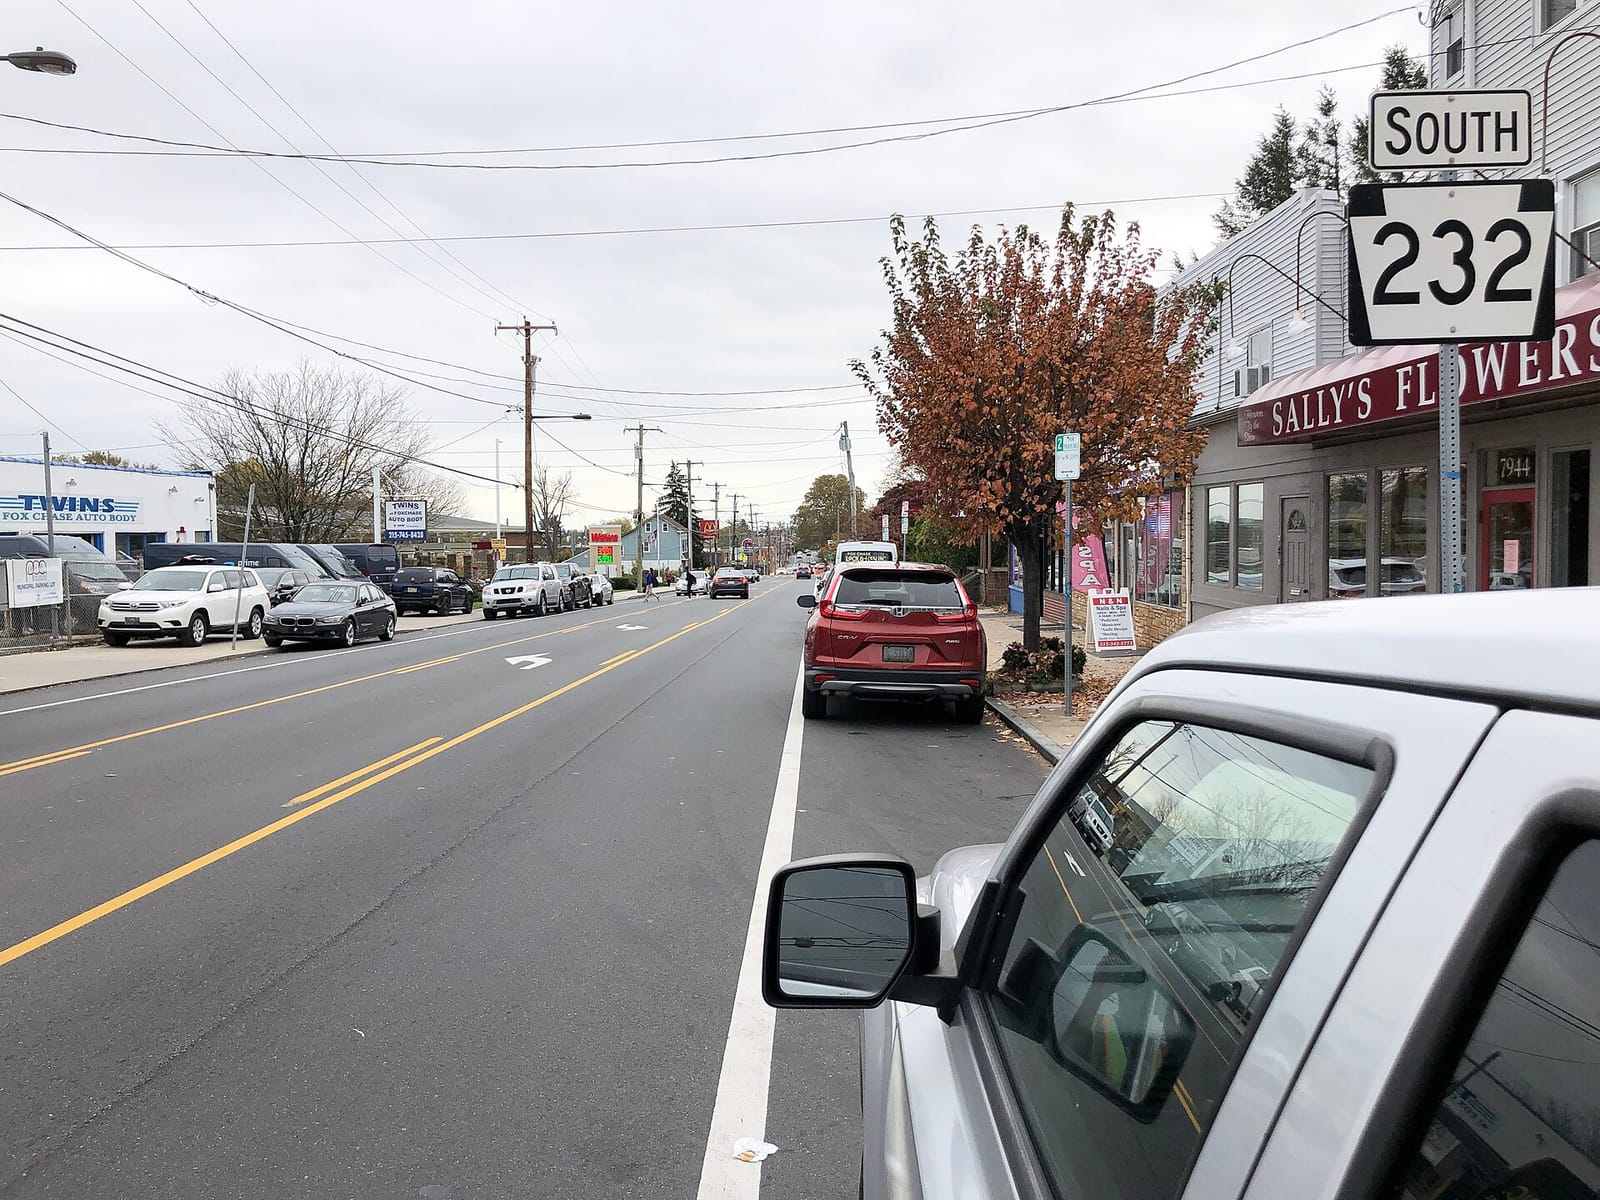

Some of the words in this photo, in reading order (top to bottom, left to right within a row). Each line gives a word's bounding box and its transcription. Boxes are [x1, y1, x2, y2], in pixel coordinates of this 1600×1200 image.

[1385, 106, 1518, 155] SOUTH
[1373, 219, 1532, 305] 232
[1272, 377, 1372, 436] SALLY'S
[1057, 438, 1062, 449] 2
[1500, 457, 1530, 478] 7944
[18, 495, 115, 512] TWINS
[392, 502, 419, 510] TWINS
[2, 512, 29, 520] FOX
[32, 512, 73, 521] CHASE
[76, 513, 106, 521] AUTO
[107, 514, 136, 522] BODY
